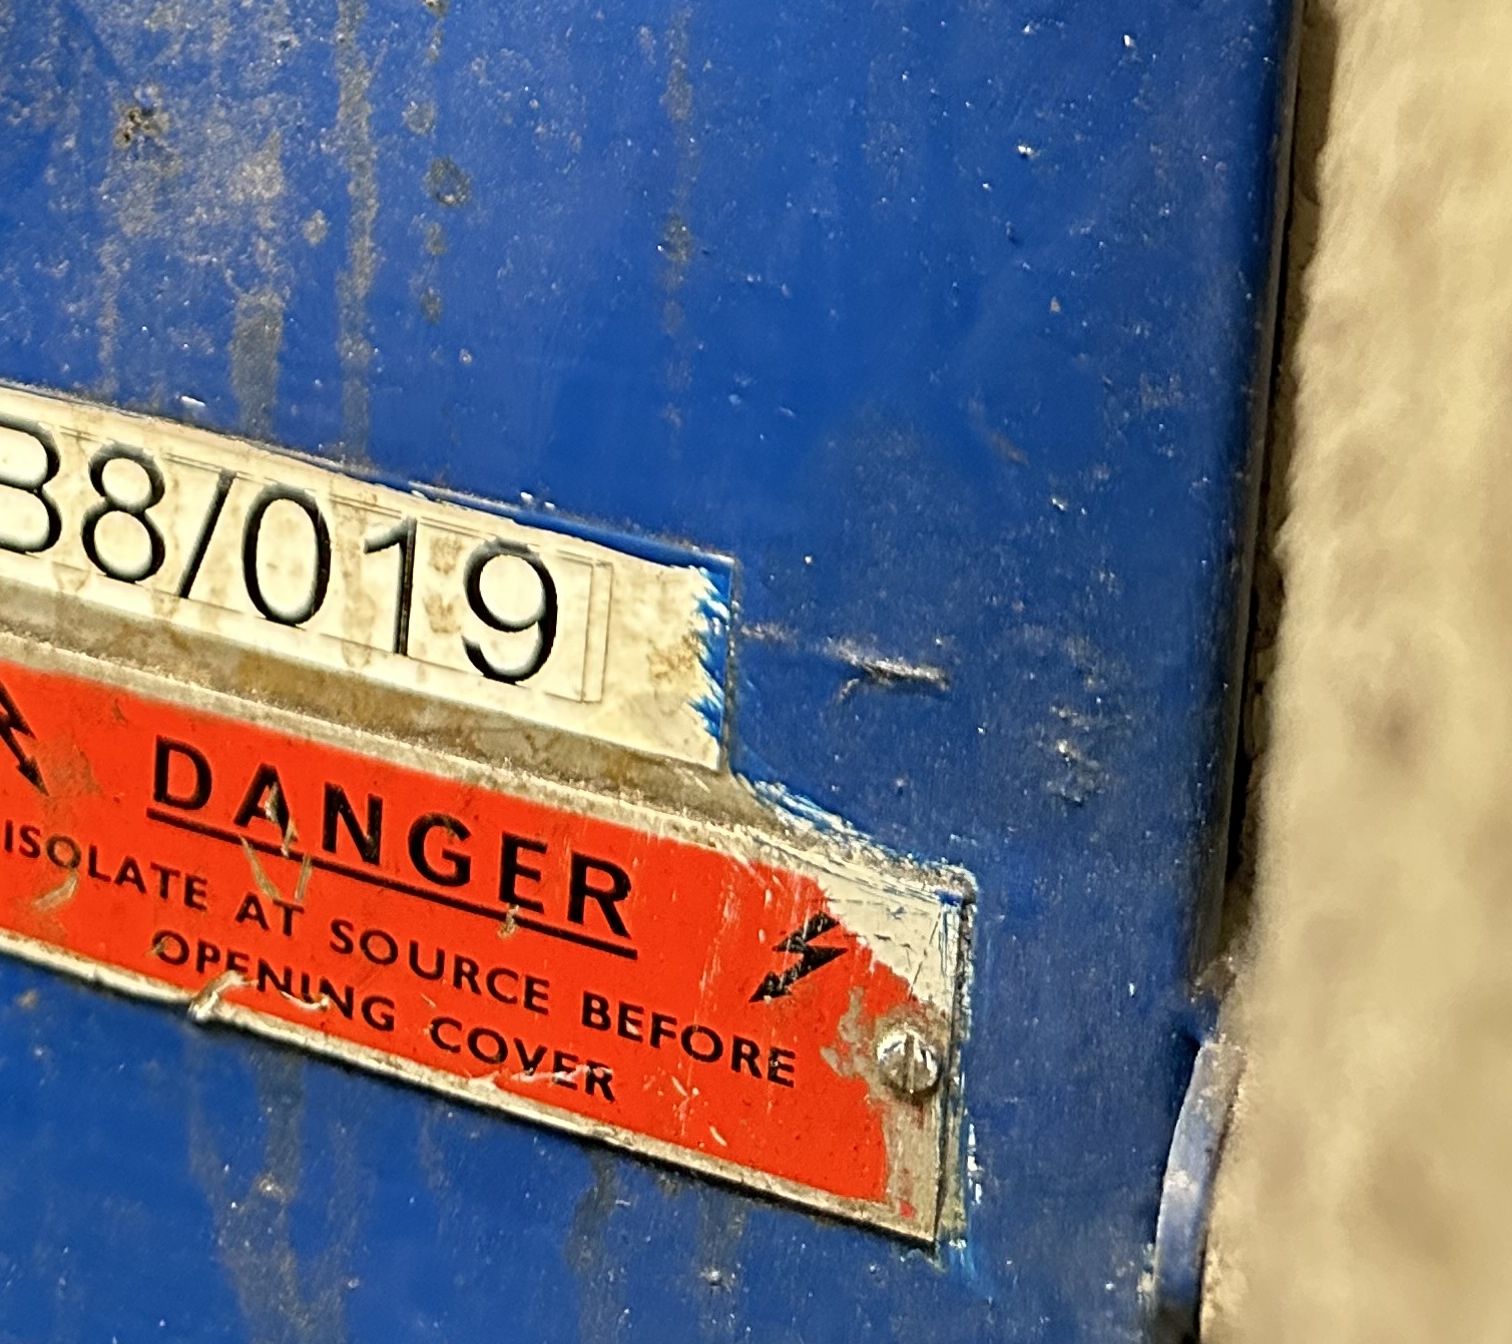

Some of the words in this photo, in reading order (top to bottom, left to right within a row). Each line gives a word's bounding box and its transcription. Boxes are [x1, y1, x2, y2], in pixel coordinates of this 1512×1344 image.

[153, 736, 633, 937] DANGER
[3, 821, 208, 911] ISOLATE
[236, 894, 304, 937] AT
[330, 919, 550, 1016] SOURCE
[584, 994, 796, 1087] BEFORE
[155, 931, 395, 1032] OPENING
[431, 1018, 617, 1101] COVER
